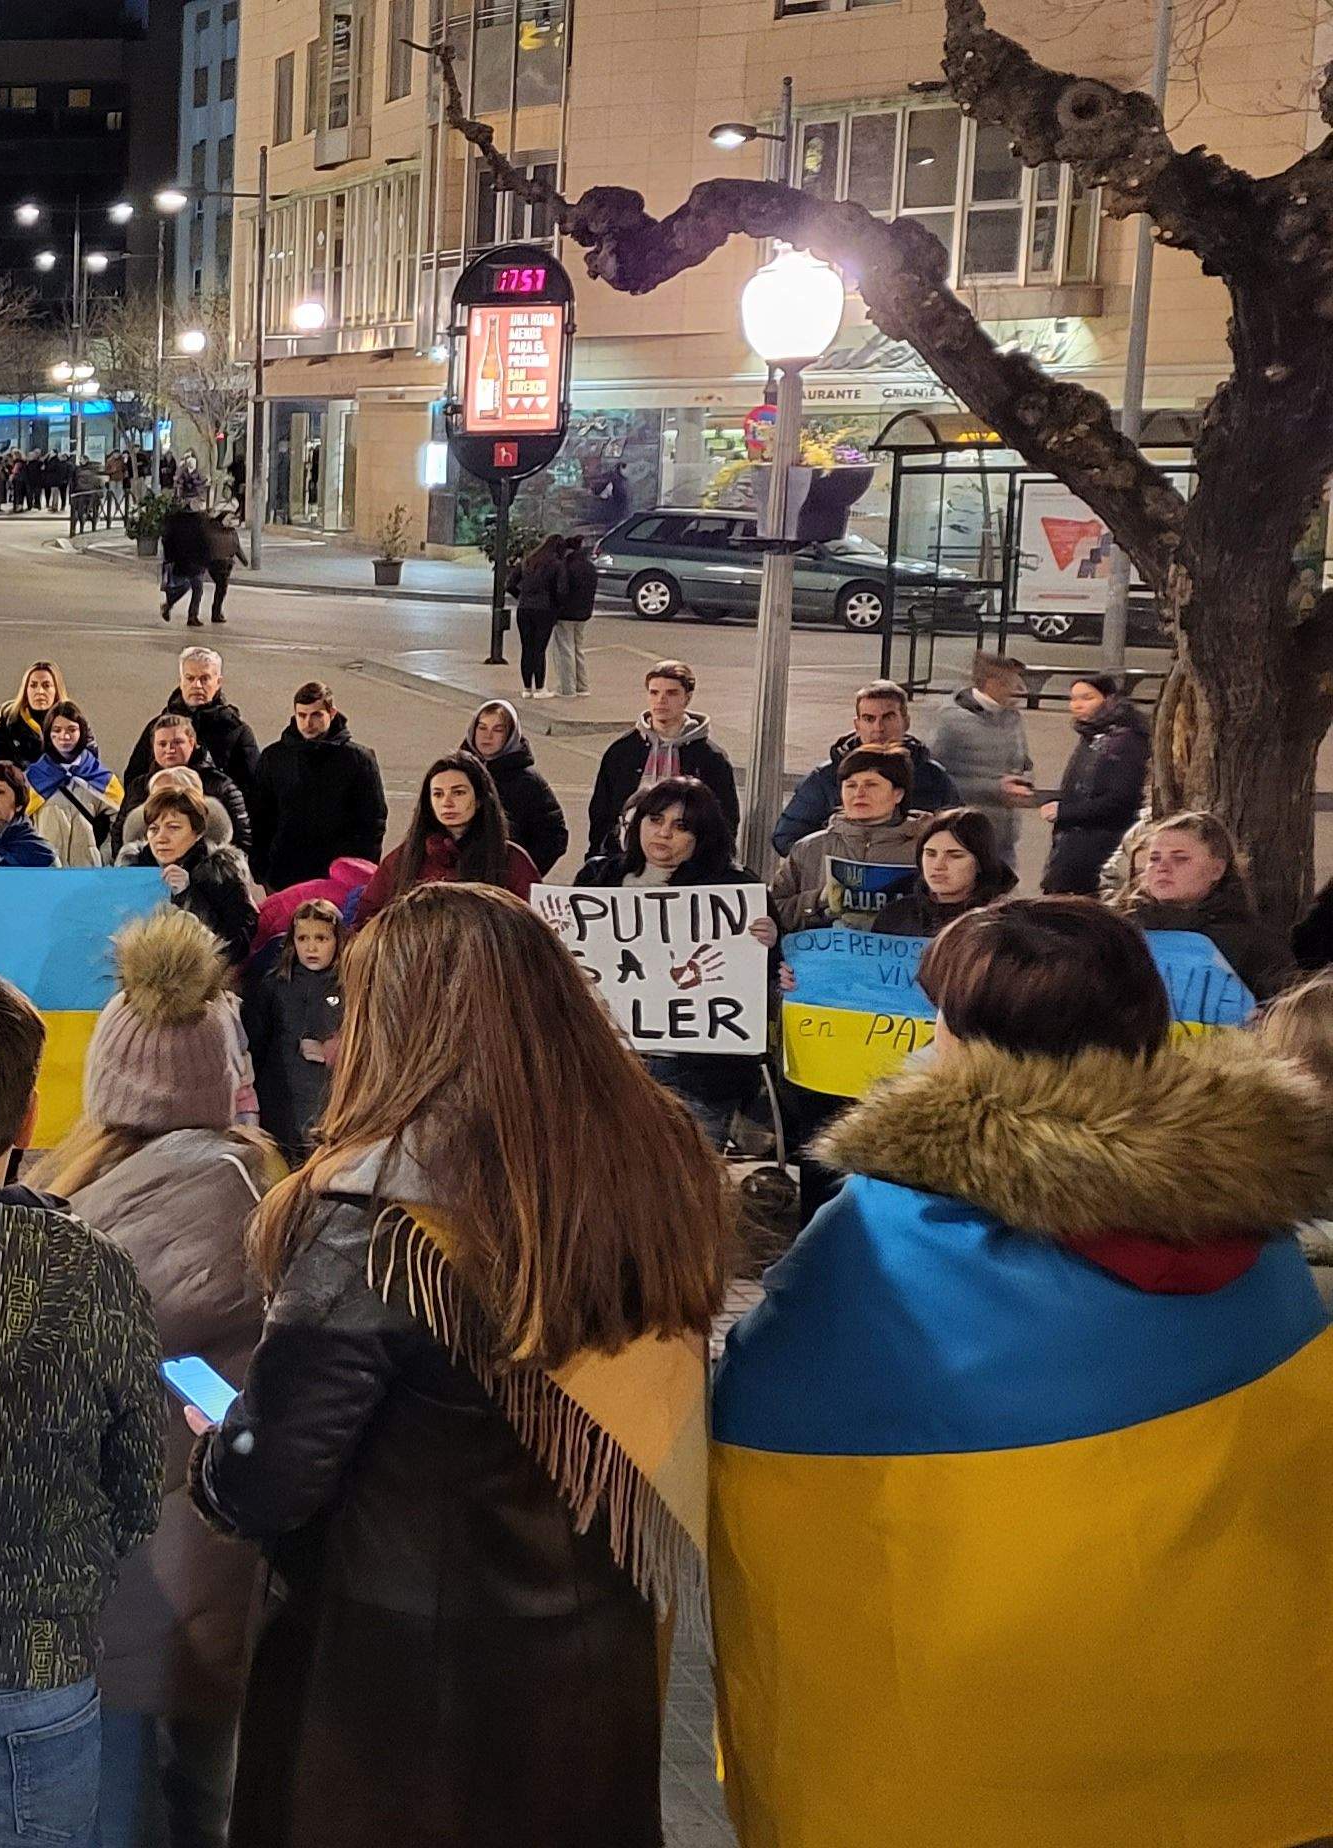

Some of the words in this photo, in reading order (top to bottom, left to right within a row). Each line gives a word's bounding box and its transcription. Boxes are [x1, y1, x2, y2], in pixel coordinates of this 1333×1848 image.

[800, 388, 862, 400] AURANTE
[569, 889, 748, 943] PUTIN
[793, 931, 925, 960] QUEREMOS
[572, 950, 602, 984] S
[616, 949, 646, 984] A
[632, 997, 750, 1040] LER
[799, 1017, 835, 1038] en
